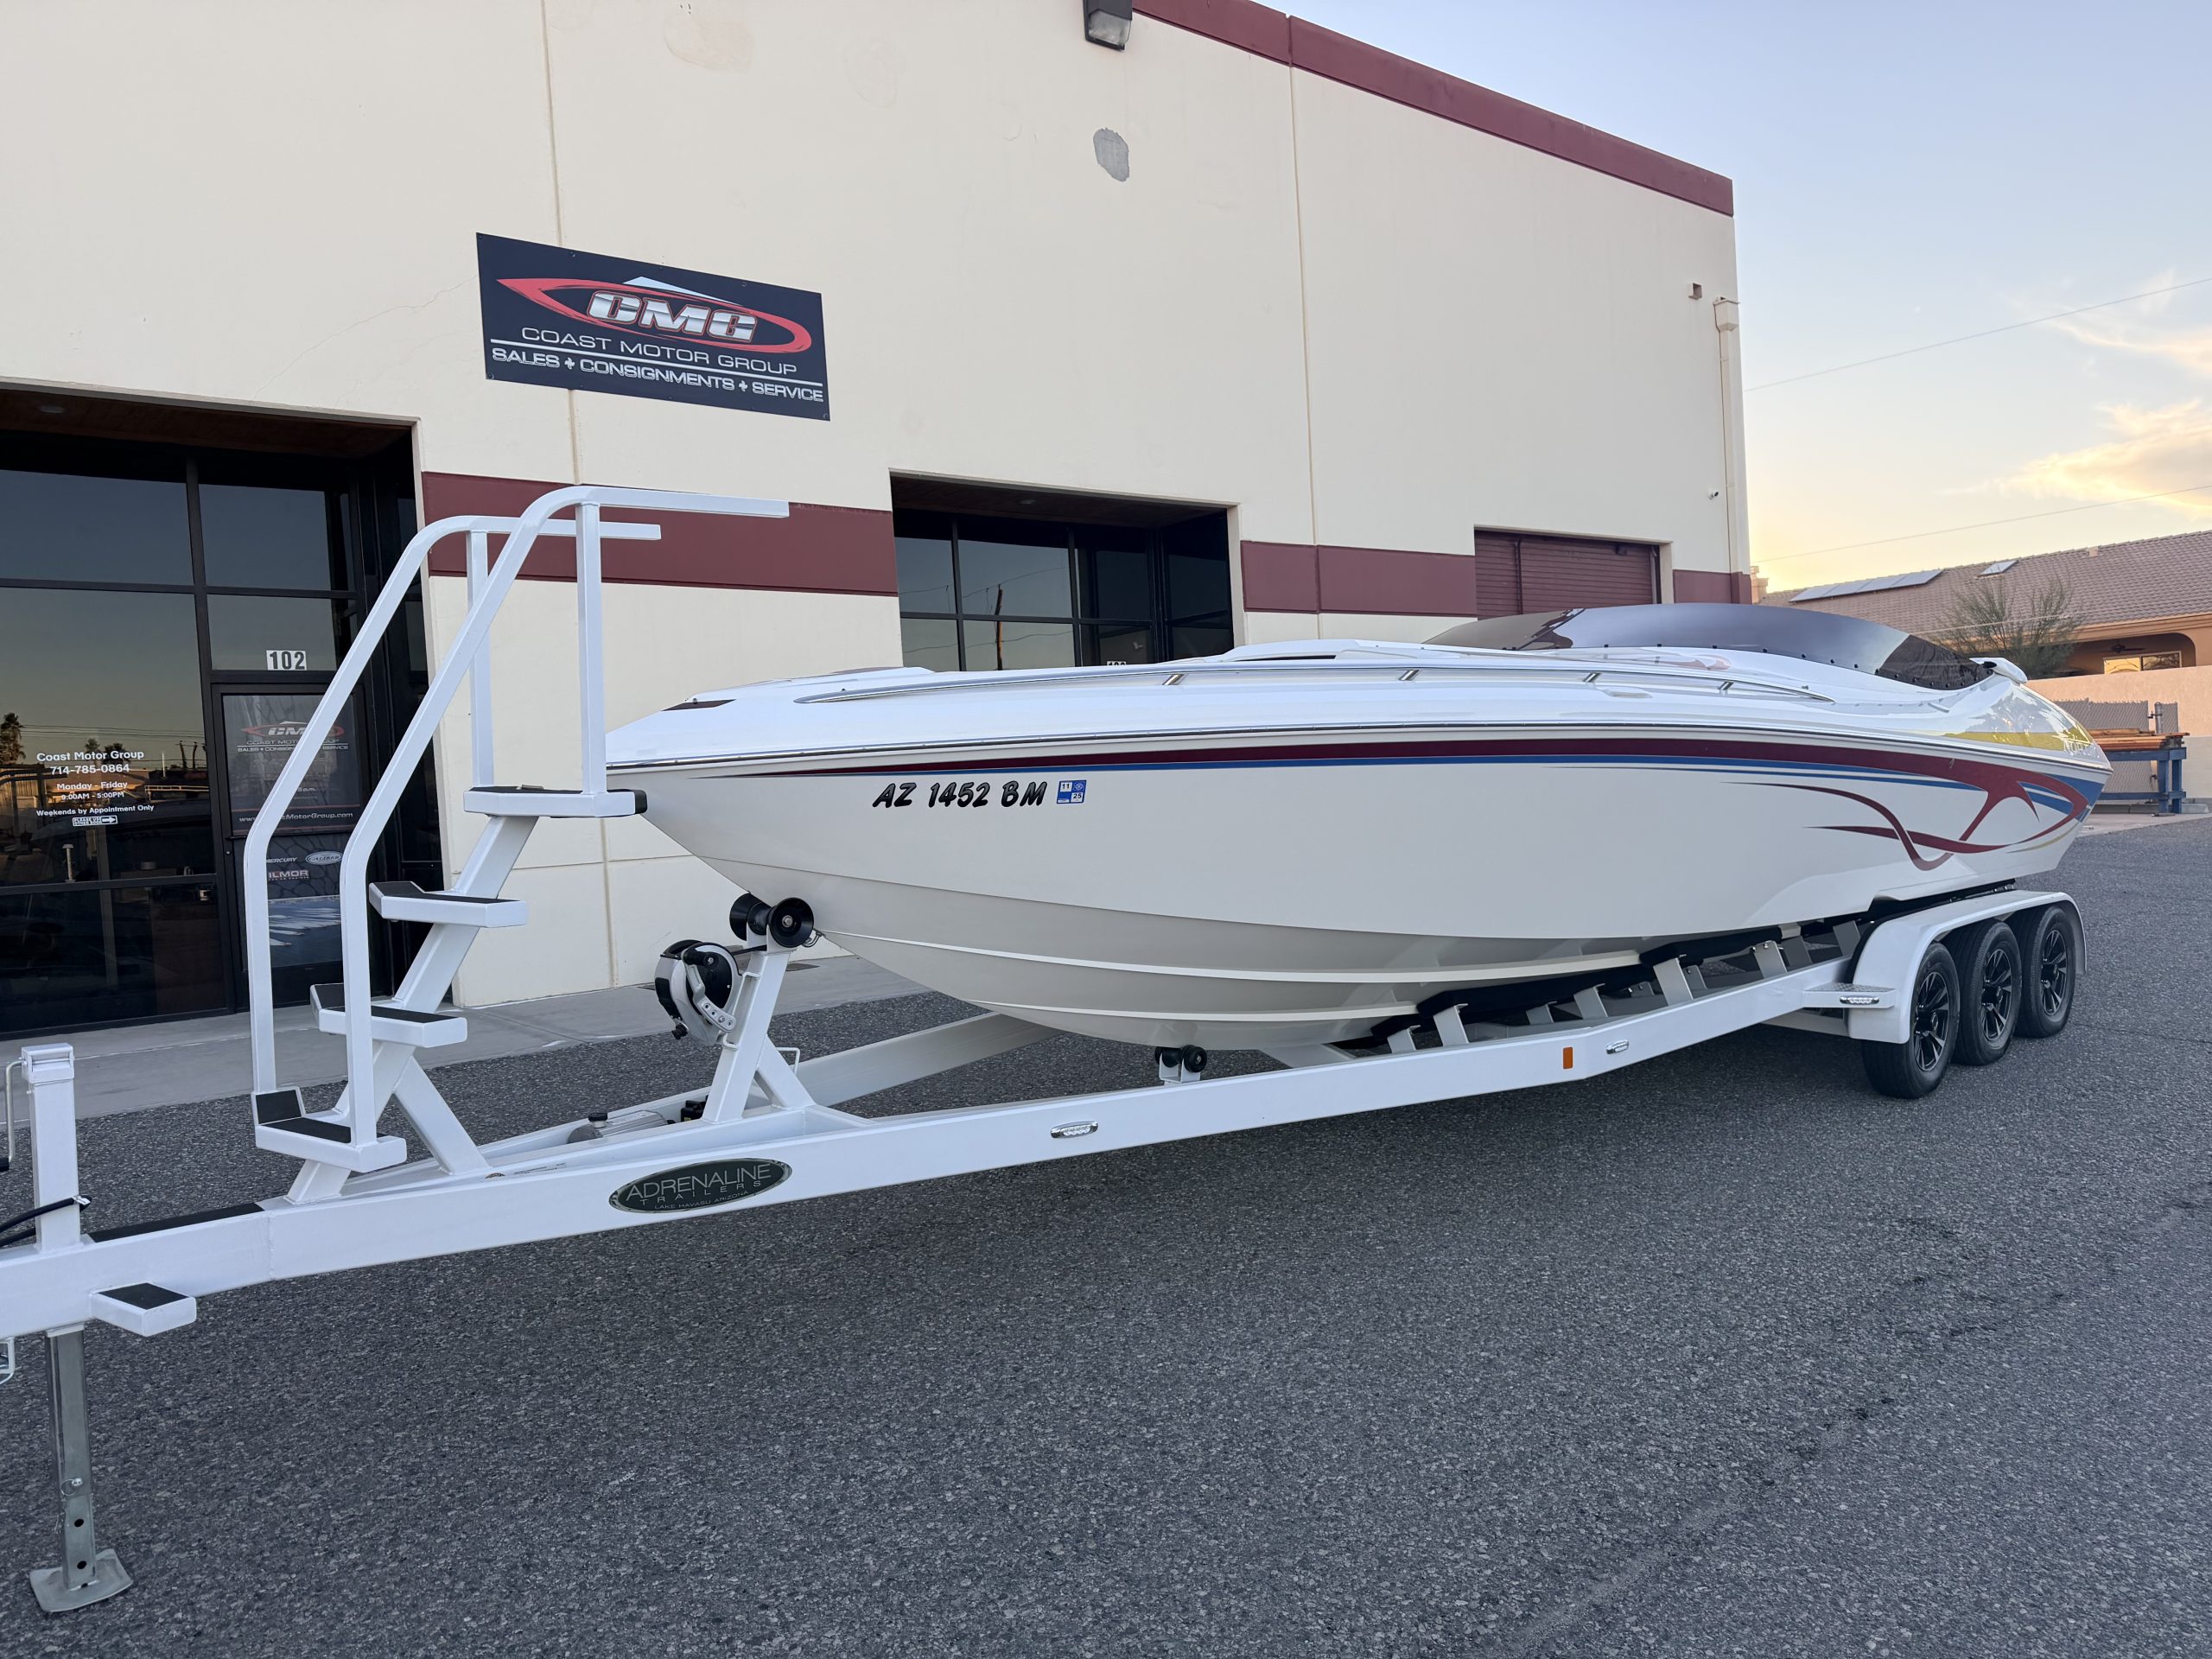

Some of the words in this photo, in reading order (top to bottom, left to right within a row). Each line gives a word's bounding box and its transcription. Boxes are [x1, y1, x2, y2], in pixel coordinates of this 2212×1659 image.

[522, 327, 611, 350] COAST
[620, 341, 710, 364] MOTOR
[718, 354, 797, 375] GROUP
[492, 347, 560, 368] SALES
[580, 359, 735, 391] CONSIGNMENTS
[753, 382, 823, 402] SERVICE
[270, 651, 305, 670] 102
[268, 727, 306, 735] CM
[36, 753, 71, 761] Coast
[74, 752, 107, 760] Motor
[110, 750, 144, 760] Group
[50, 764, 130, 775] 714-785-0864
[56, 783, 92, 792] Monday
[872, 782, 917, 808] AZ
[928, 781, 990, 808] 1452
[1001, 780, 1047, 808] BM
[89, 805, 136, 815] Appointment
[268, 869, 308, 878] ILMOR
[626, 1163, 772, 1201] ADRENALINE
[640, 1180, 761, 1205] TRAILERS
[678, 1199, 711, 1209] HAVASU
[714, 1190, 749, 1203] ARIZONA
